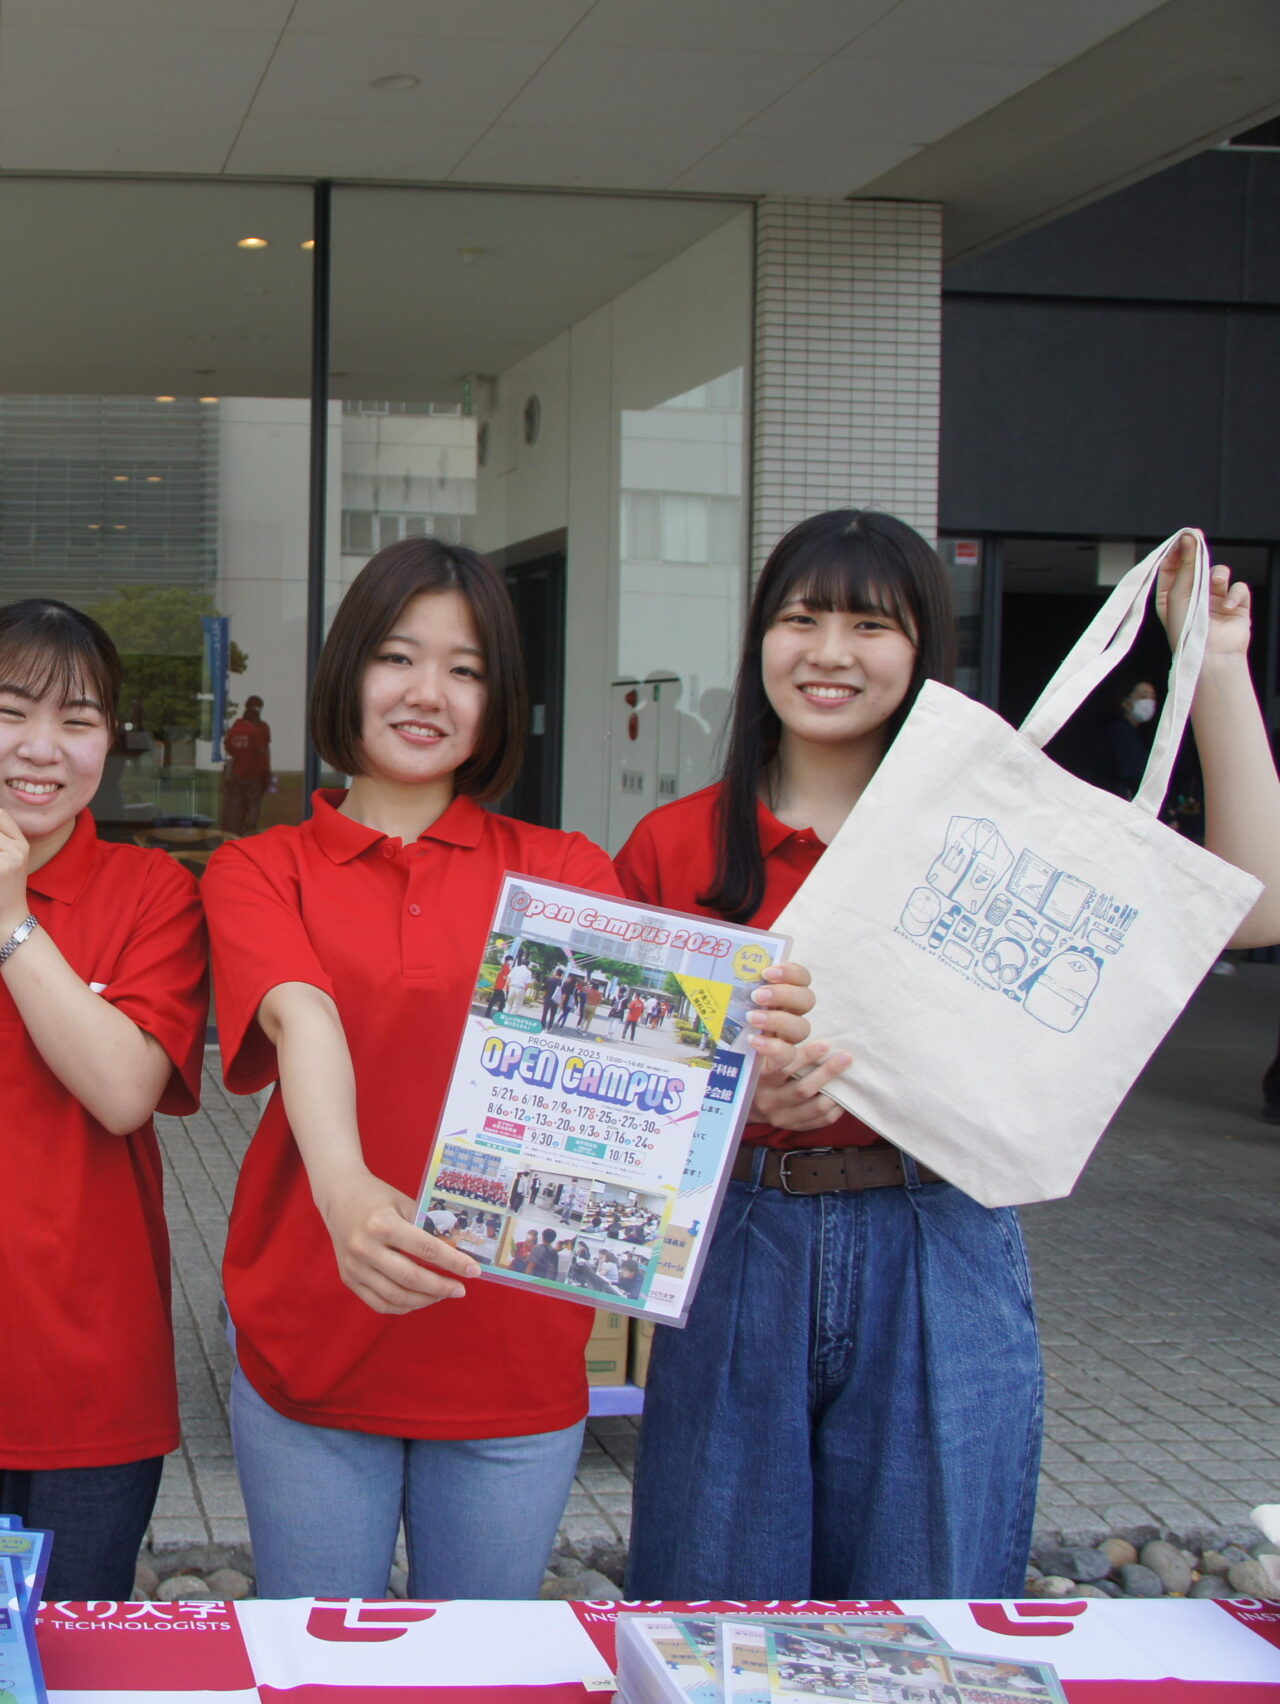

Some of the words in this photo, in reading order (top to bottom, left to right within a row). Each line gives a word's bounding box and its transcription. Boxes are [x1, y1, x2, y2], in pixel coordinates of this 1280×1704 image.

[510, 891, 575, 925] Open
[576, 906, 672, 948] Campus
[672, 928, 732, 959] 2023
[528, 1036, 575, 1053] PROGRAM
[577, 1047, 600, 1059] 2023
[480, 1035, 559, 1089] OPEN
[561, 1053, 685, 1117] CAMPUS
[51, 1619, 231, 1631] TECHNOLOGISTS
